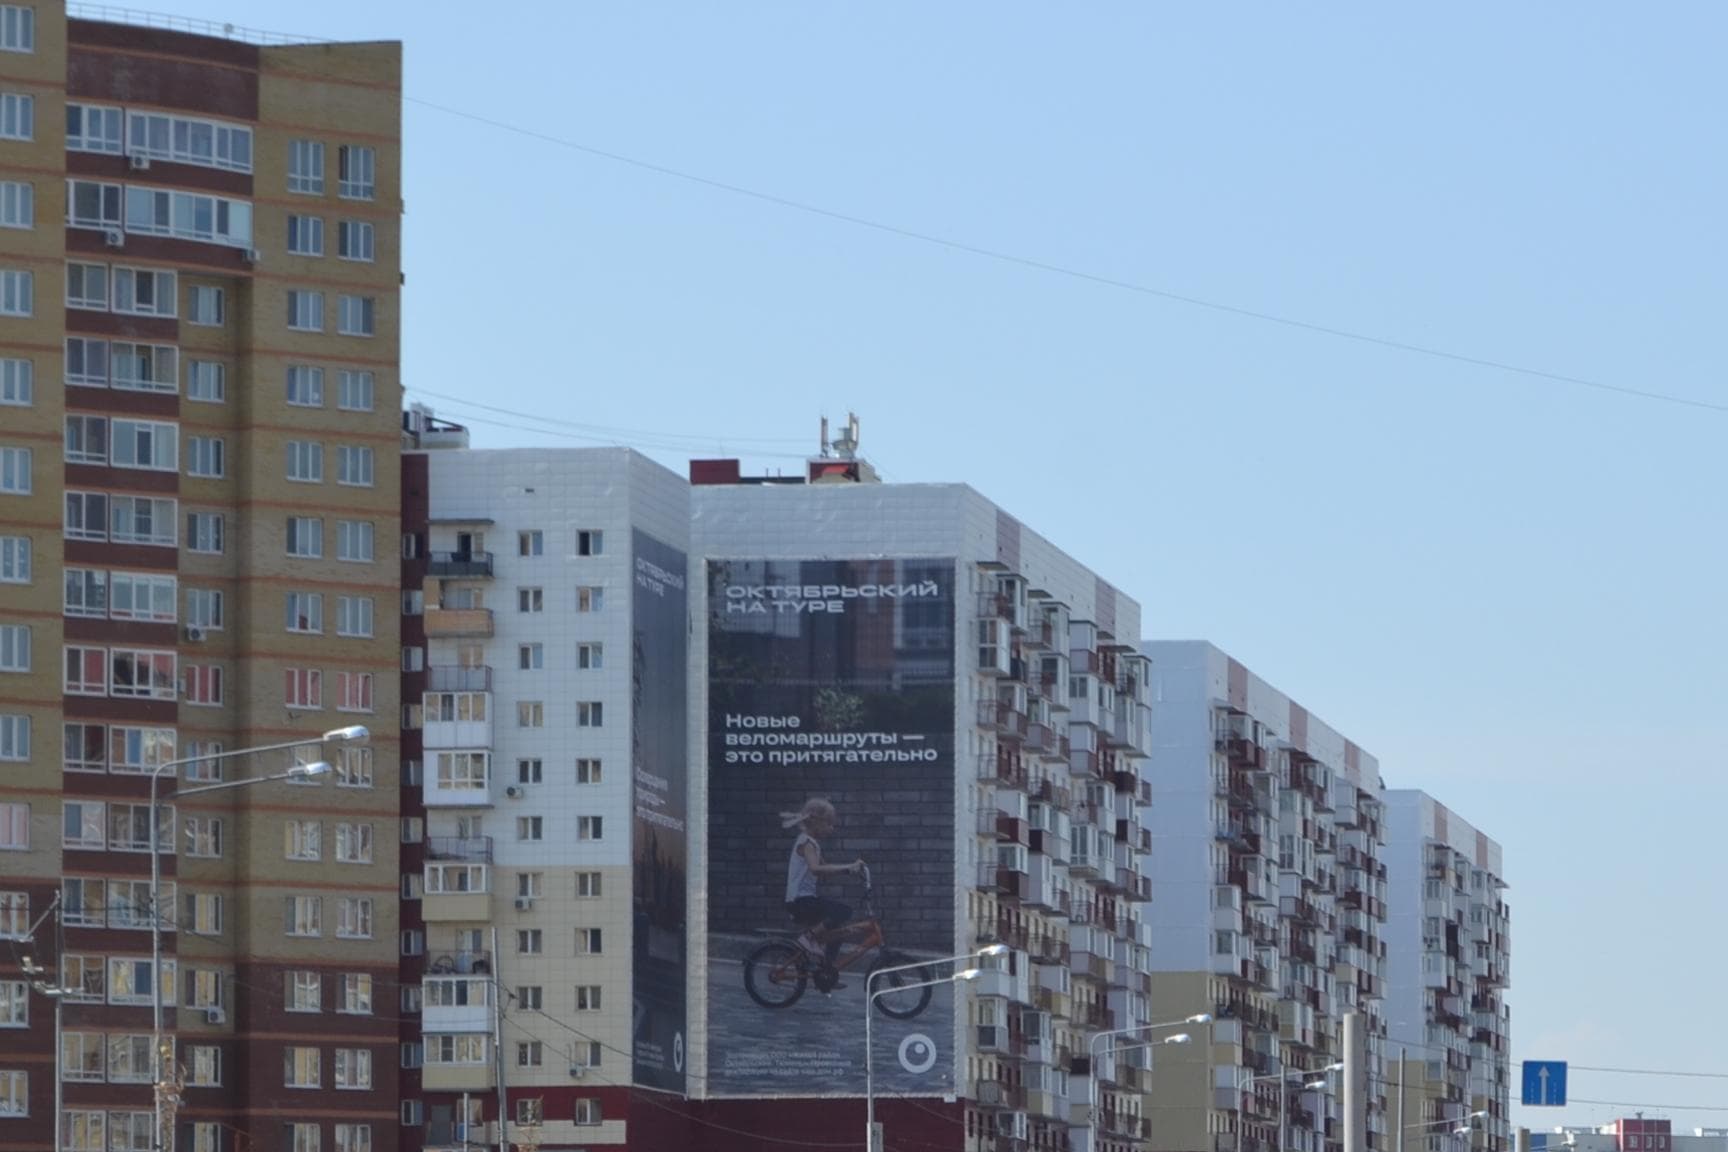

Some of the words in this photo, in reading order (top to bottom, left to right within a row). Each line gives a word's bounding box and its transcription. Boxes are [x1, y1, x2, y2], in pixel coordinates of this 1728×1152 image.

[726, 579, 938, 599] ОКТЯБРЬСКИЙ
[726, 599, 766, 614] НА
[771, 598, 845, 614] ТУРЕ
[726, 713, 800, 729] Новые
[725, 731, 898, 750] веломаршруты
[725, 748, 764, 763] это
[769, 747, 938, 766] притягательно
